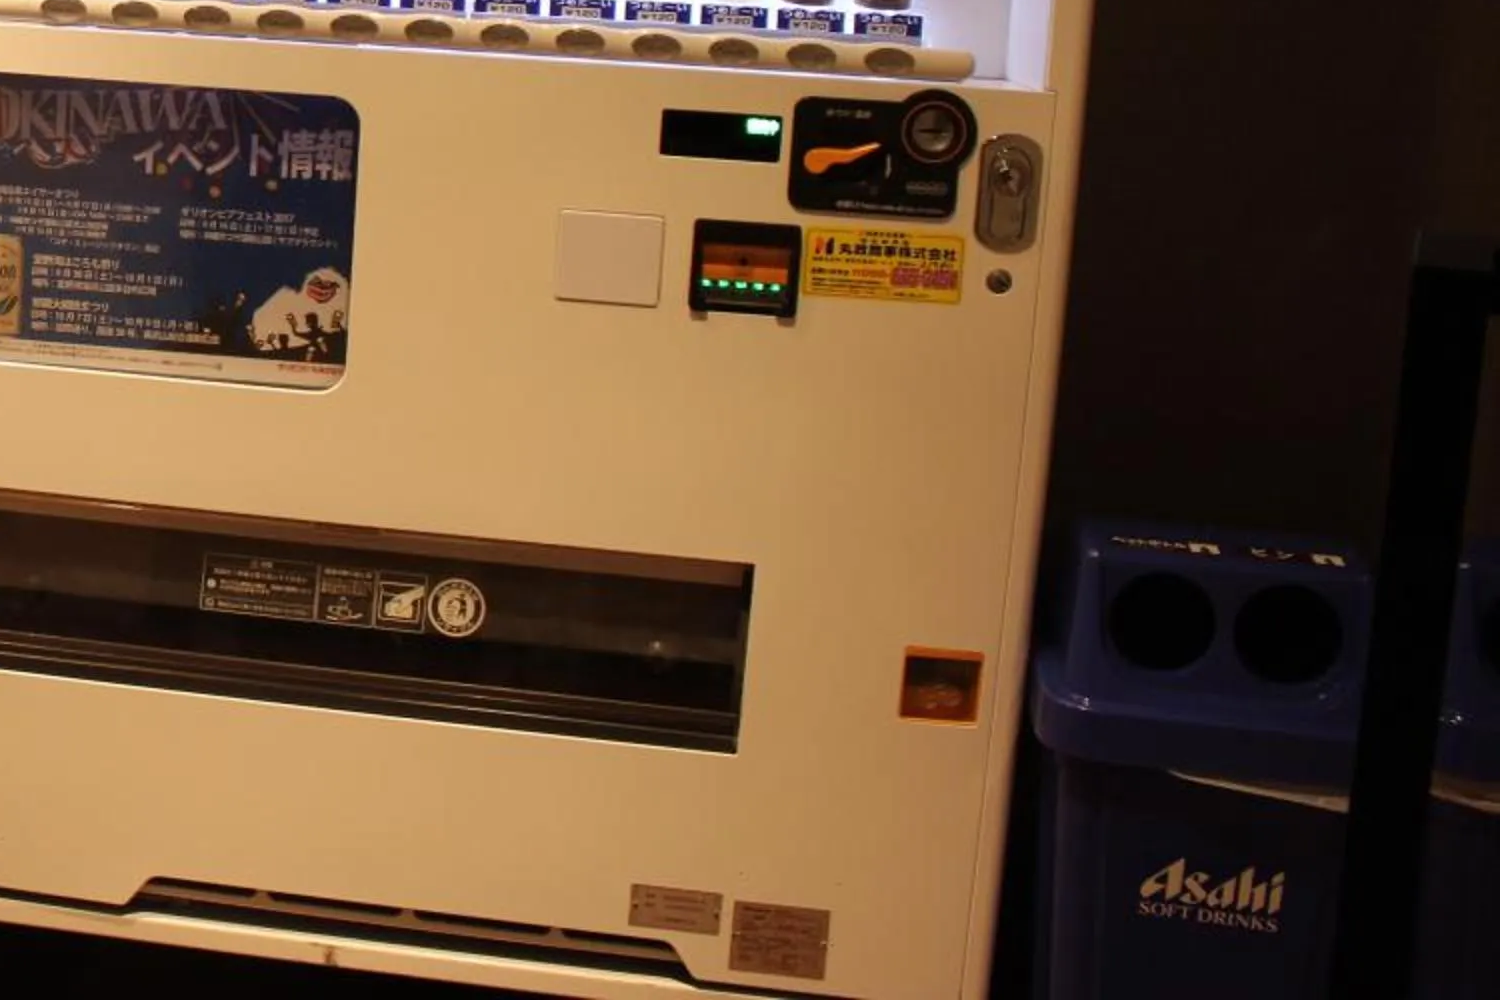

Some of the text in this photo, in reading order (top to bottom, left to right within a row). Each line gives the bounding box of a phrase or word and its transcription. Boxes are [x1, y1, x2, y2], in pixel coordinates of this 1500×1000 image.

[133, 129, 353, 181] イベント情報
[1139, 857, 1286, 915] Asahi
[1138, 901, 1280, 933] SOFT DRINKS
